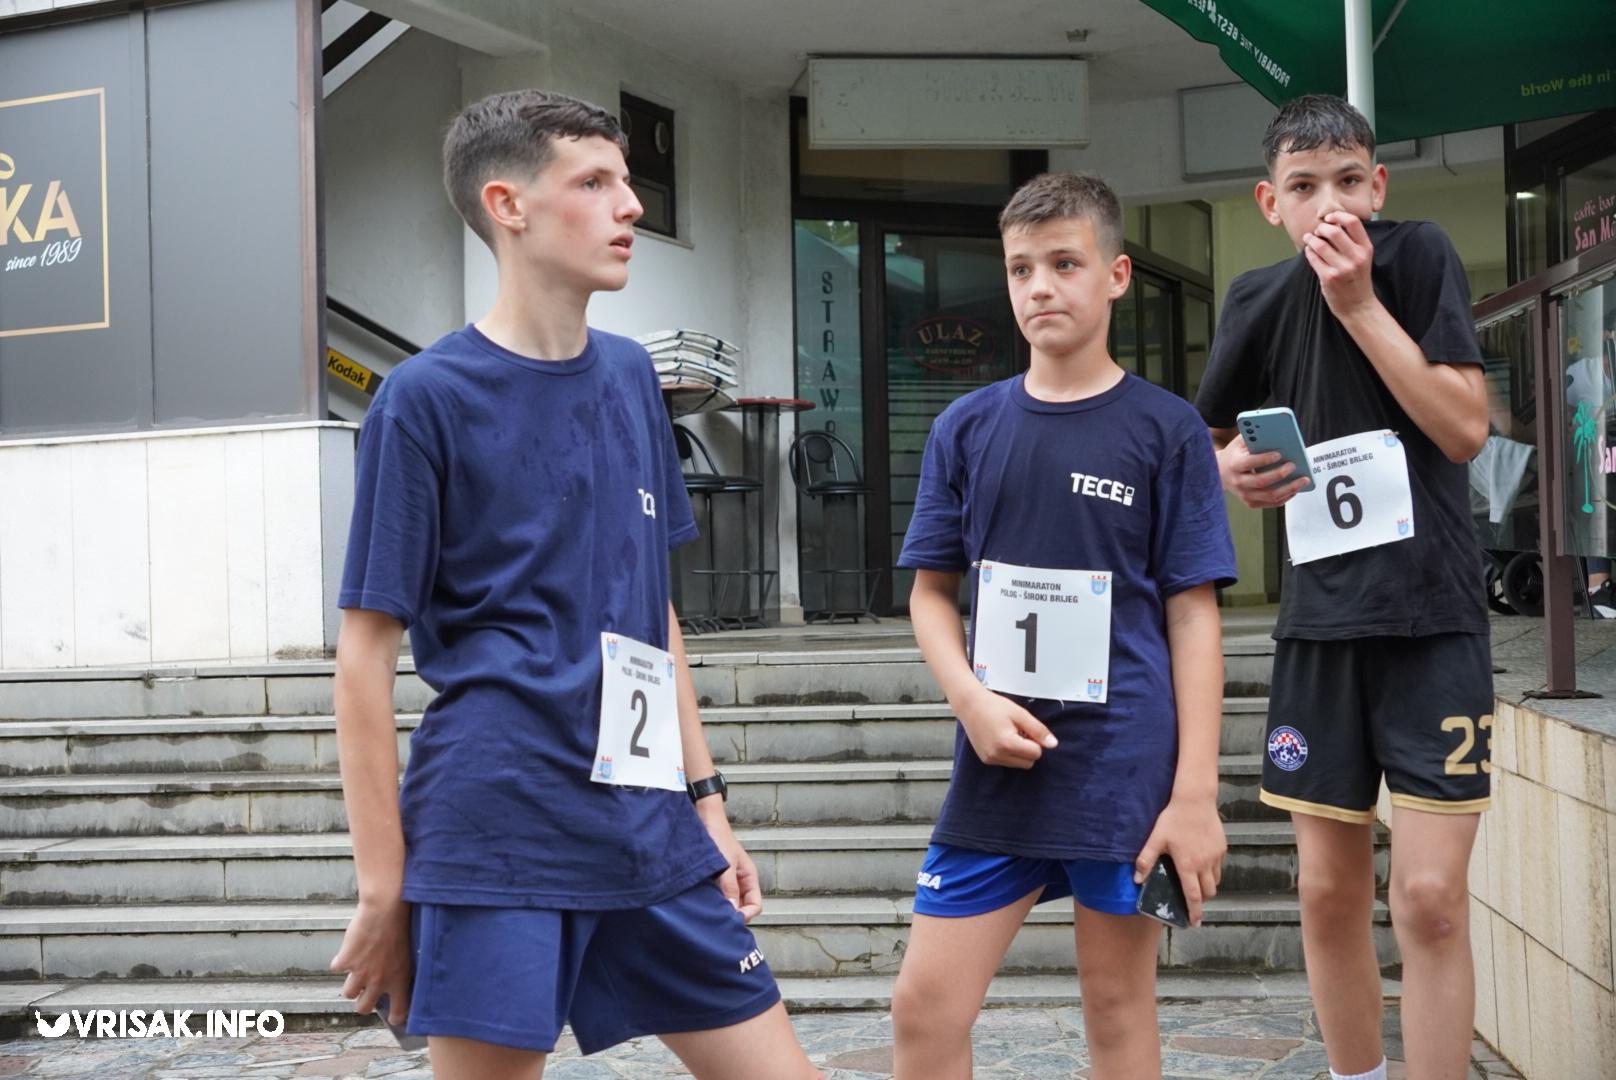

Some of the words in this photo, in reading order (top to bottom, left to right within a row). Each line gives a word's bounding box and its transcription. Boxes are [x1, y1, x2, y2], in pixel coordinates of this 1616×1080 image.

[1575, 226, 1597, 252] San
[5, 254, 37, 272] since
[40, 237, 82, 267] 1989
[918, 323, 984, 347] ULAZ
[327, 355, 366, 387] Kodak
[1313, 447, 1357, 464] MINIMARATON
[1070, 473, 1125, 503] TECE
[1326, 475, 1363, 530] 6
[1011, 579, 1061, 592] MINIMARATON
[1050, 595, 1079, 604] BRIJEG
[1015, 612, 1038, 673] 1
[629, 689, 650, 758] 2
